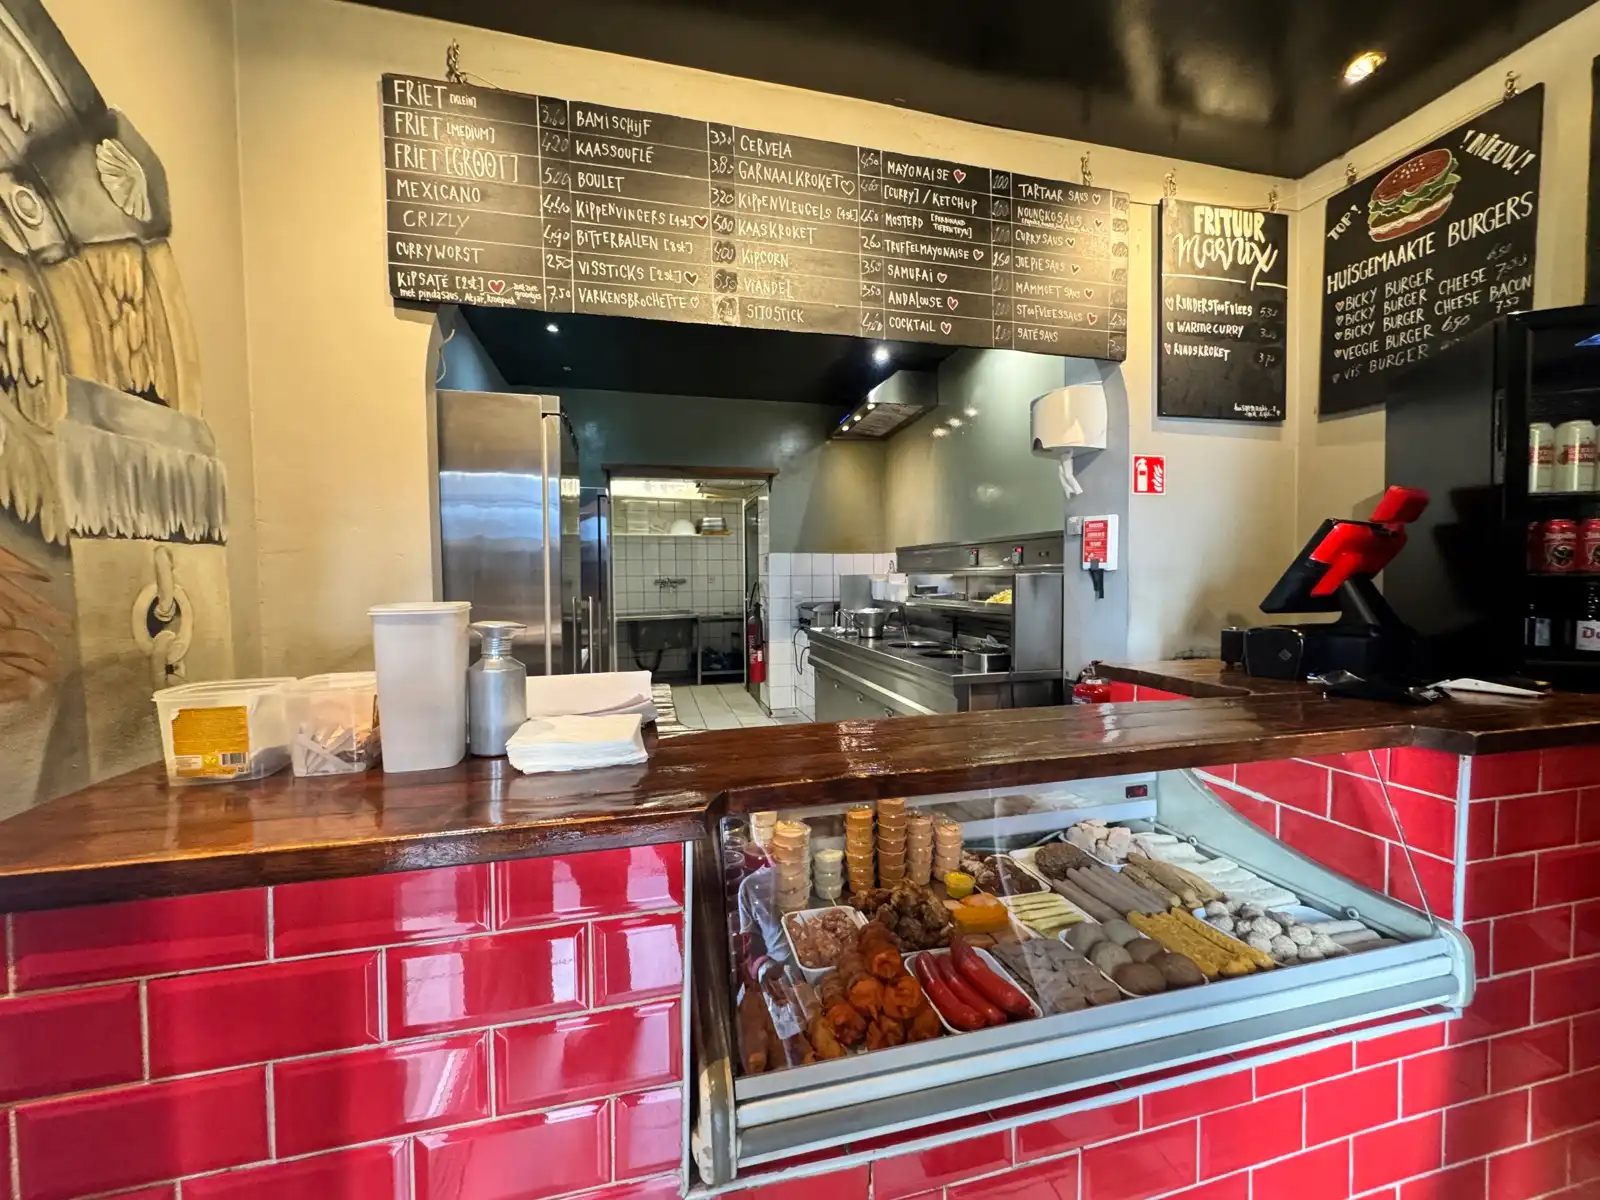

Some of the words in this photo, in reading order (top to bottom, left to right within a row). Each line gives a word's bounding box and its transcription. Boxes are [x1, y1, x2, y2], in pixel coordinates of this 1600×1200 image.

[576, 140, 654, 164] KAASSOUFLÉ
[740, 134, 792, 158] CERVELA
[578, 172, 625, 192] BOULET
[738, 160, 844, 192] GARNAALKROKET
[1018, 184, 1064, 202] TARTAAR
[402, 210, 470, 236] CRIZLY
[738, 218, 818, 244] KAASKROKET
[886, 212, 924, 230] MOSTERD
[1194, 206, 1266, 244] FRITUUR
[1448, 190, 1534, 248] BURGERS
[396, 242, 485, 264] CURRYWORST
[400, 288, 416, 298] met
[1384, 288, 1428, 316] BURGER
[1438, 267, 1488, 296] CHEESE
[1385, 268, 1435, 298] BURGER
[1384, 308, 1425, 332] BURGER
[1434, 289, 1482, 316] CHEESE
[1489, 274, 1532, 302] BACON
[1386, 324, 1435, 350] BURGER
[1369, 344, 1429, 374] BURGER
